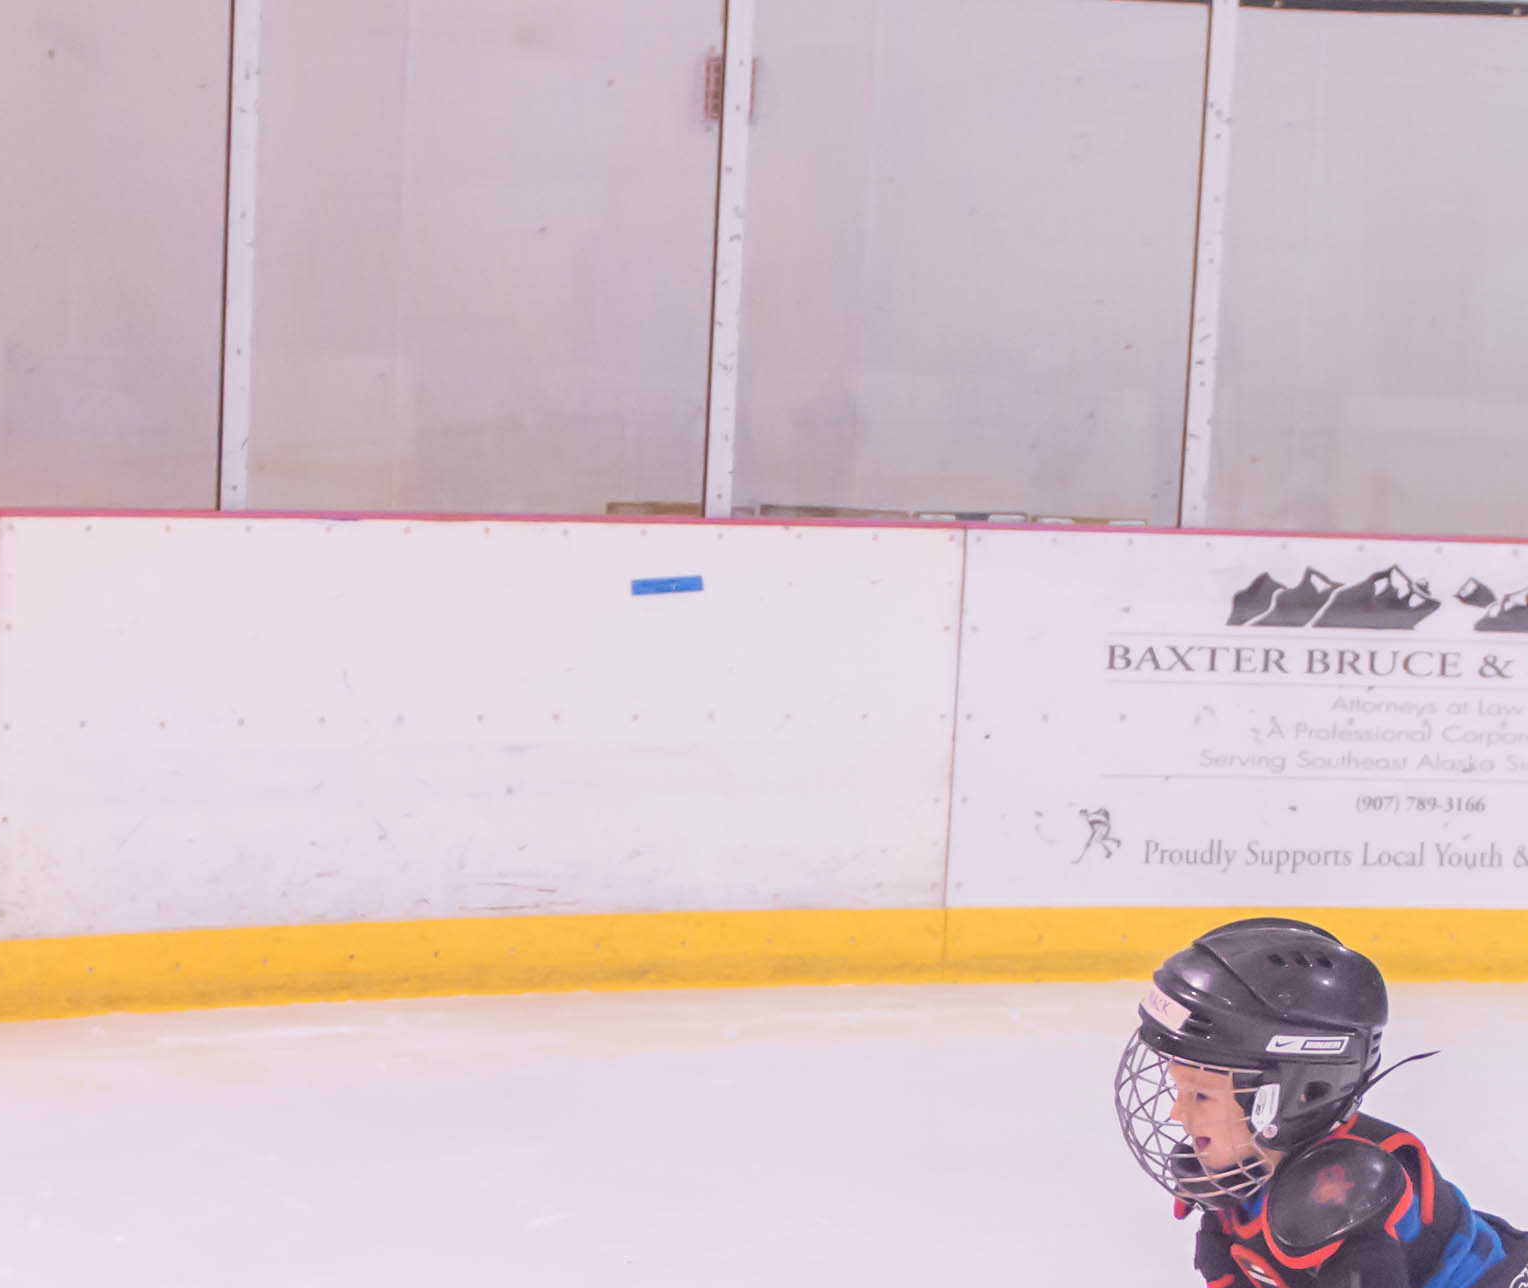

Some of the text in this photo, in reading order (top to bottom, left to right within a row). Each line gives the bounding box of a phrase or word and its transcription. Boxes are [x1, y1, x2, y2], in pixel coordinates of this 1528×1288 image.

[1105, 643, 1289, 674] BAXTER
[1303, 648, 1462, 679] BRUCE
[1477, 653, 1514, 680] &
[1330, 696, 1524, 718] Attorneys at Law
[1200, 749, 1287, 772] Serving
[1296, 751, 1408, 770] Southeast
[1417, 752, 1495, 771] Alaska
[1355, 795, 1486, 814] (907) 789-3166
[1143, 838, 1237, 872] Proudly
[1245, 840, 1352, 874] Supports
[1361, 841, 1425, 867] Local
[1435, 842, 1504, 870] Youth
